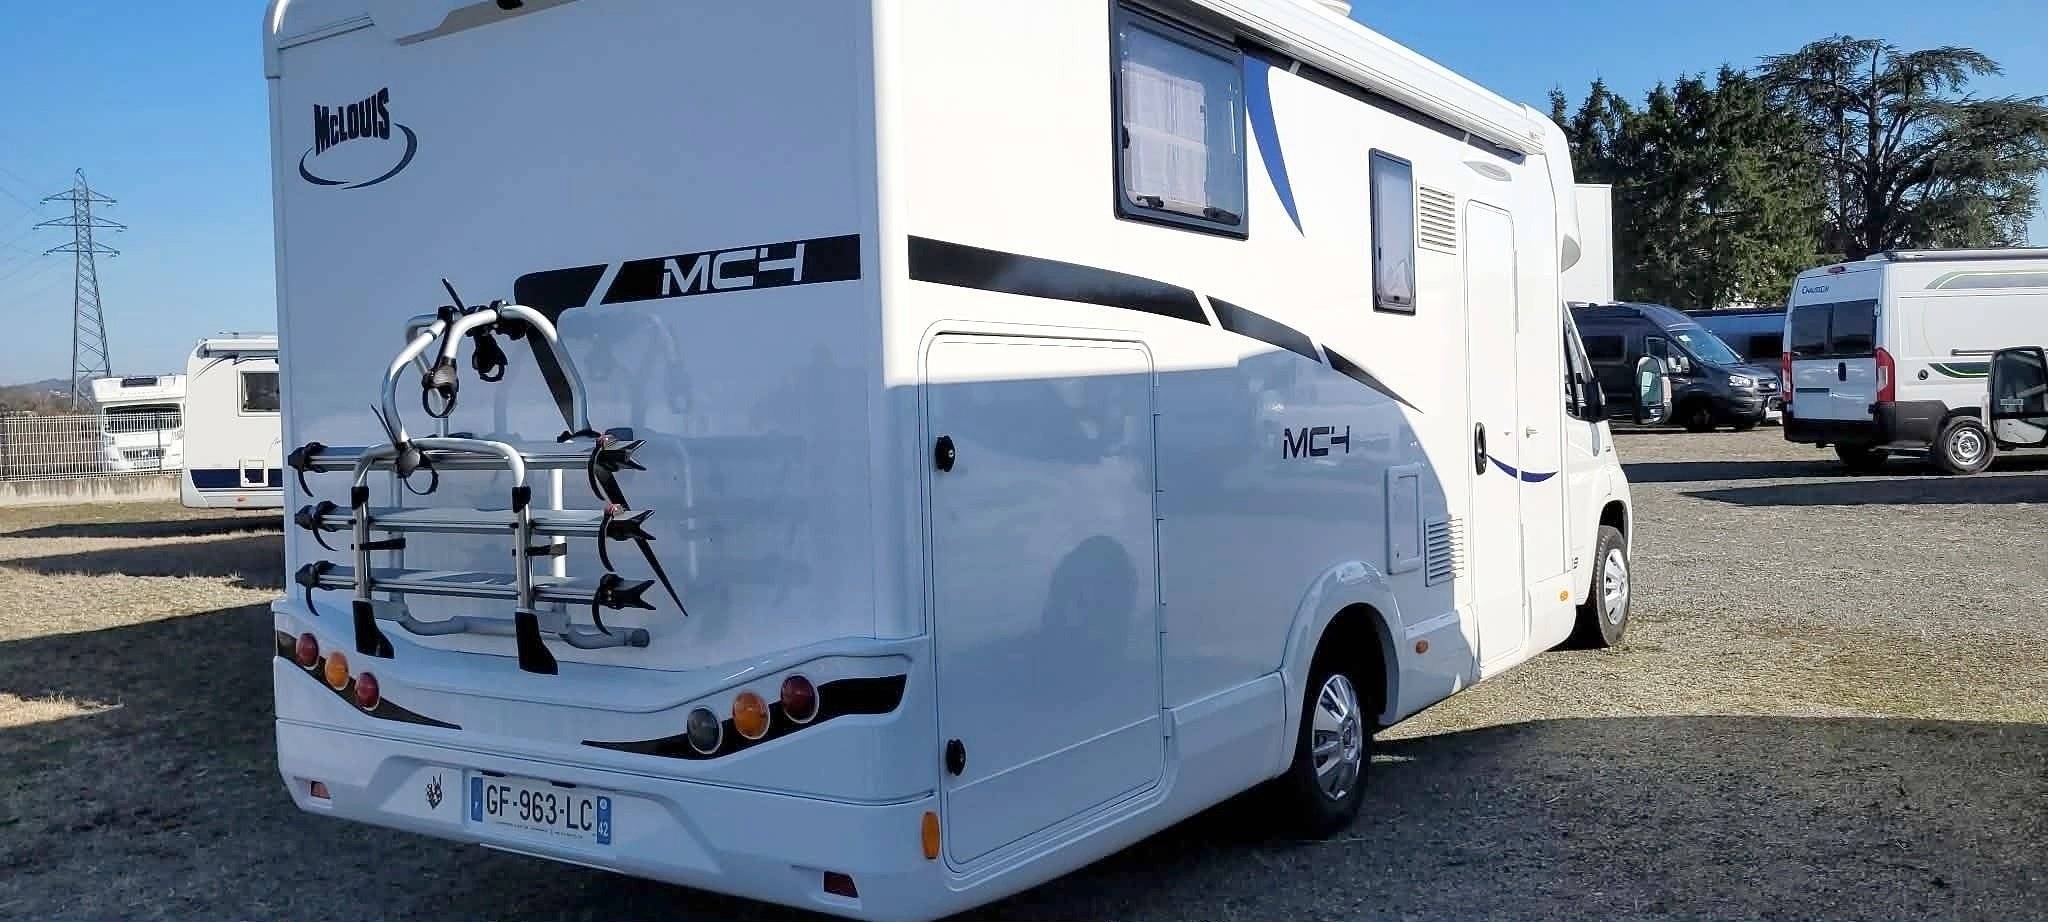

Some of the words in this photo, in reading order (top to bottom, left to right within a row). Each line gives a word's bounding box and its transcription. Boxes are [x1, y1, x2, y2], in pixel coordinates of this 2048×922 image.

[313, 87, 391, 157] McLOUIS
[661, 243, 805, 296] MC4
[1282, 425, 1350, 460] MC4
[486, 784, 593, 831] GF-963-LC
[598, 821, 609, 837] 42
